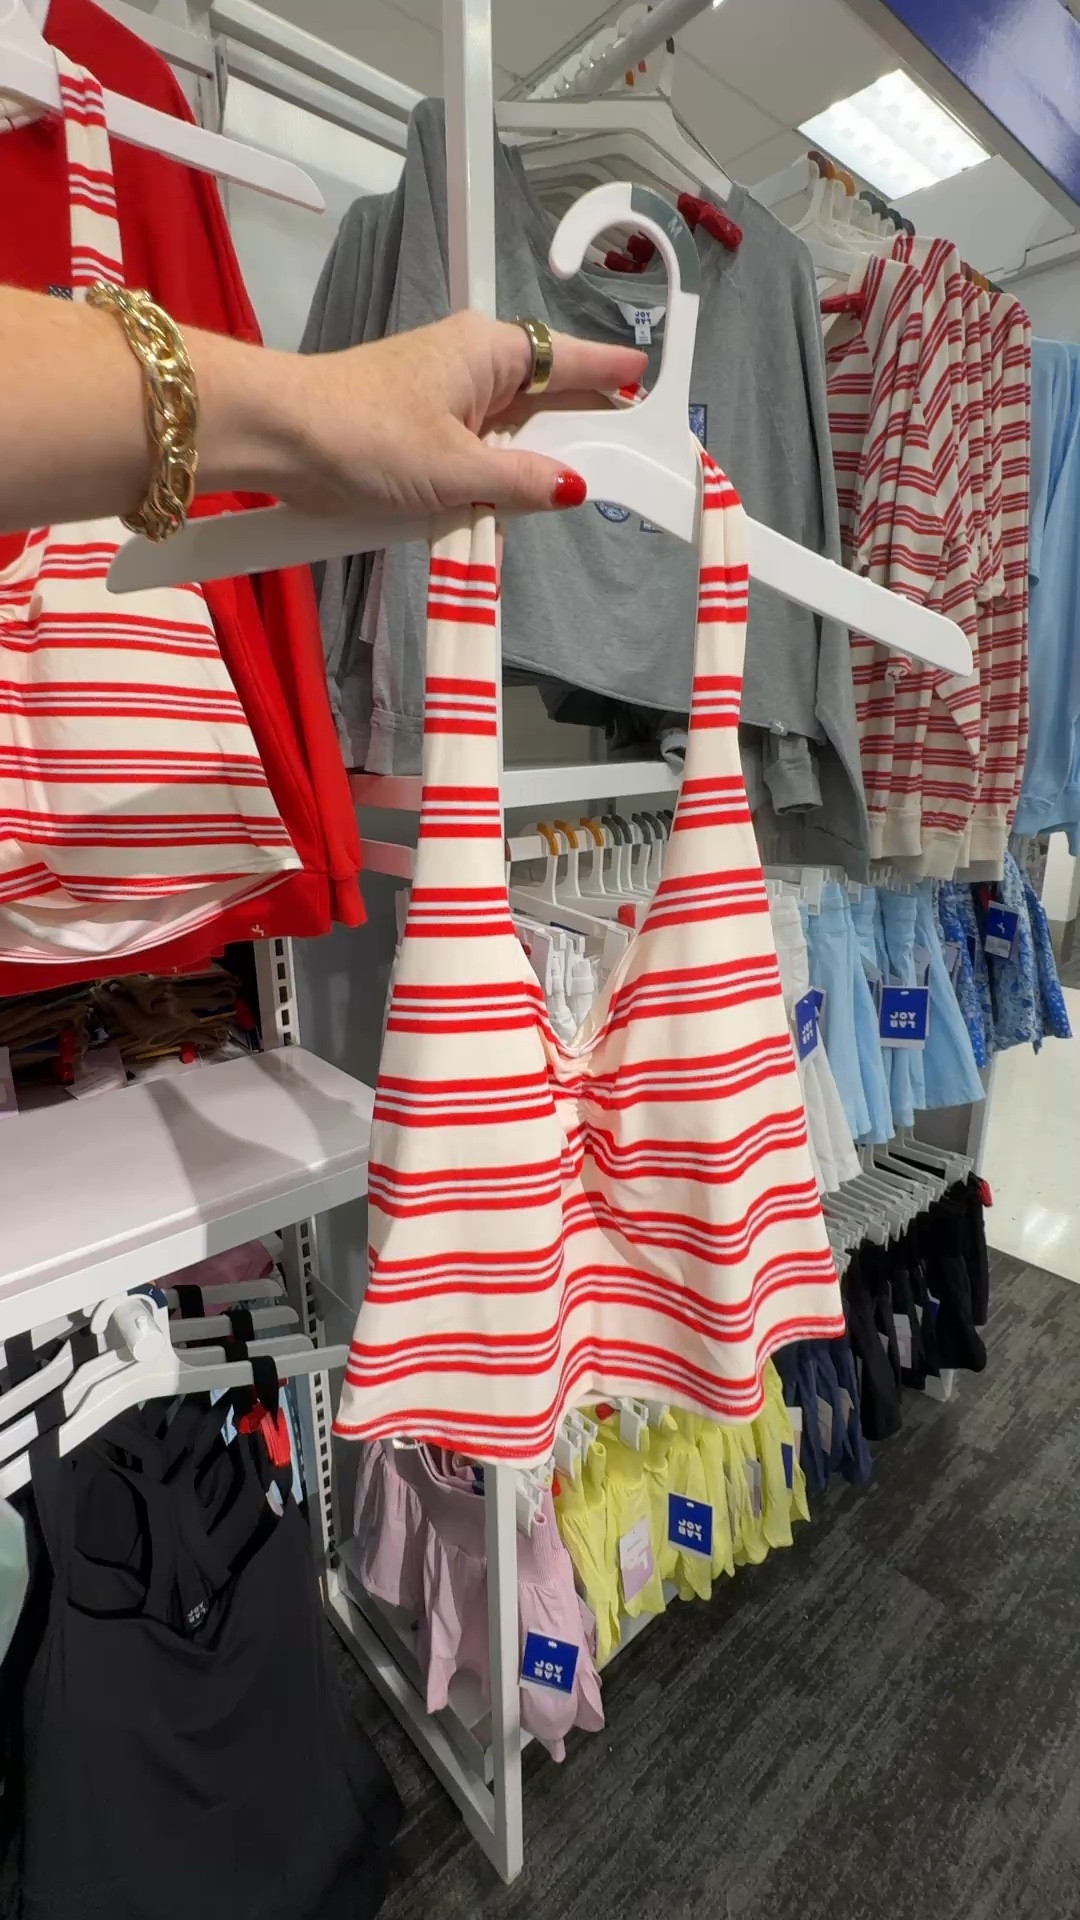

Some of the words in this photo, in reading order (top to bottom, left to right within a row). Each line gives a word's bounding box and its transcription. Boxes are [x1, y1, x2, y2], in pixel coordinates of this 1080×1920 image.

[890, 1011, 917, 1021] JOY
[802, 1018, 813, 1034] JOY
[890, 1020, 916, 1029] LAB
[678, 1519, 703, 1532] JOY
[678, 1526, 702, 1541] LAB
[188, 1601, 204, 1617] JOY
[534, 1660, 563, 1675] JOY
[534, 1667, 562, 1683] LAB
